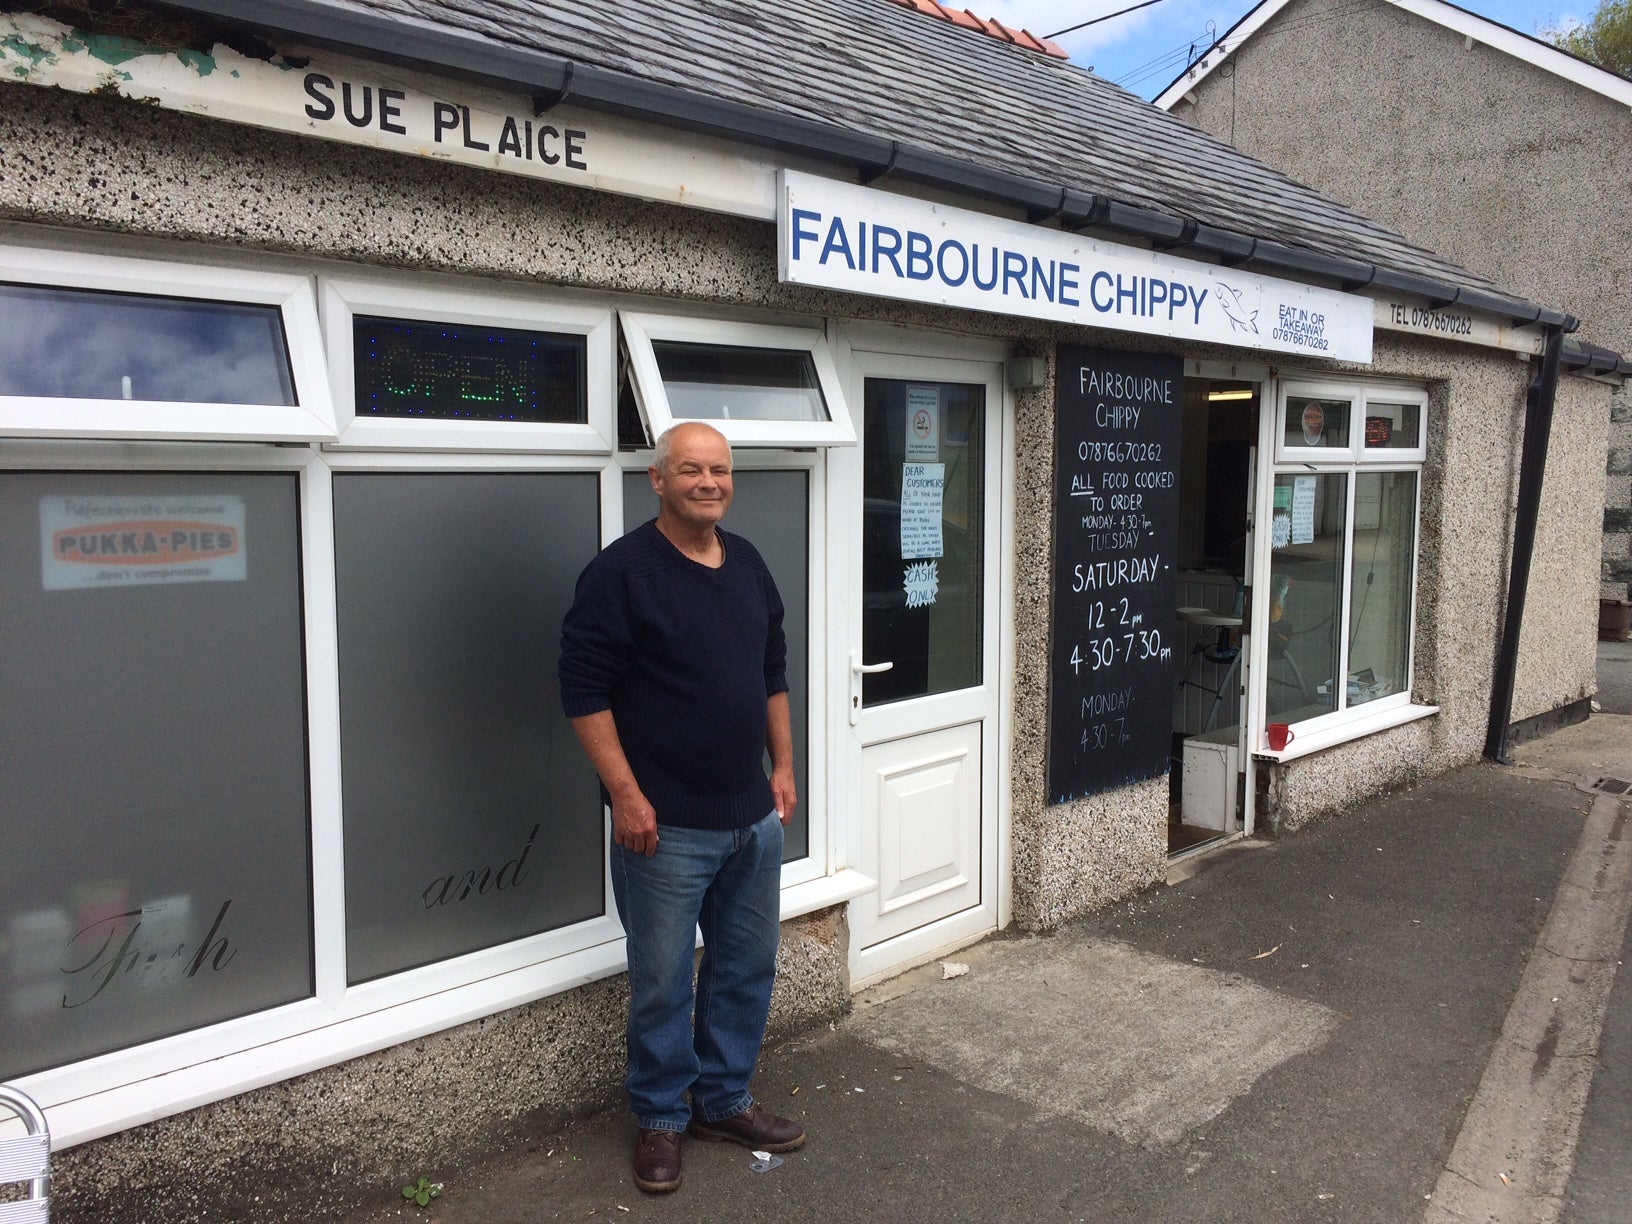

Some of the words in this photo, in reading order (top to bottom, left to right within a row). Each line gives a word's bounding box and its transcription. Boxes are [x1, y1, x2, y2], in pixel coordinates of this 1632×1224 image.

[303, 73, 406, 135] SUE
[434, 101, 587, 171] PLAICE
[792, 208, 1080, 307] FAIRBOURNE
[1090, 271, 1208, 325] CHIPPY
[1279, 304, 1298, 319] EAT
[1299, 311, 1307, 322] IN
[1311, 312, 1325, 327] OR
[1279, 316, 1324, 338] TAKEAWAY
[1391, 303, 1409, 326] TEL
[1412, 308, 1472, 335] 07876670262
[1273, 328, 1328, 351] 07876670262
[380, 347, 528, 403] OPEN
[1080, 366, 1173, 404] FAIRBOURNE
[1096, 403, 1141, 430] CHIPPY
[1079, 441, 1162, 463] 07876670262
[905, 465, 925, 477] DEAR
[1071, 473, 1095, 491] ALL
[1103, 472, 1129, 489] FOOD
[1135, 471, 1175, 489] COOKED
[906, 478, 945, 489] CUSTOMERS
[1090, 497, 1104, 512] TO
[1111, 494, 1143, 511] ORDER
[907, 568, 934, 583] CASH
[909, 588, 935, 604] ONLY
[422, 824, 540, 910] and
